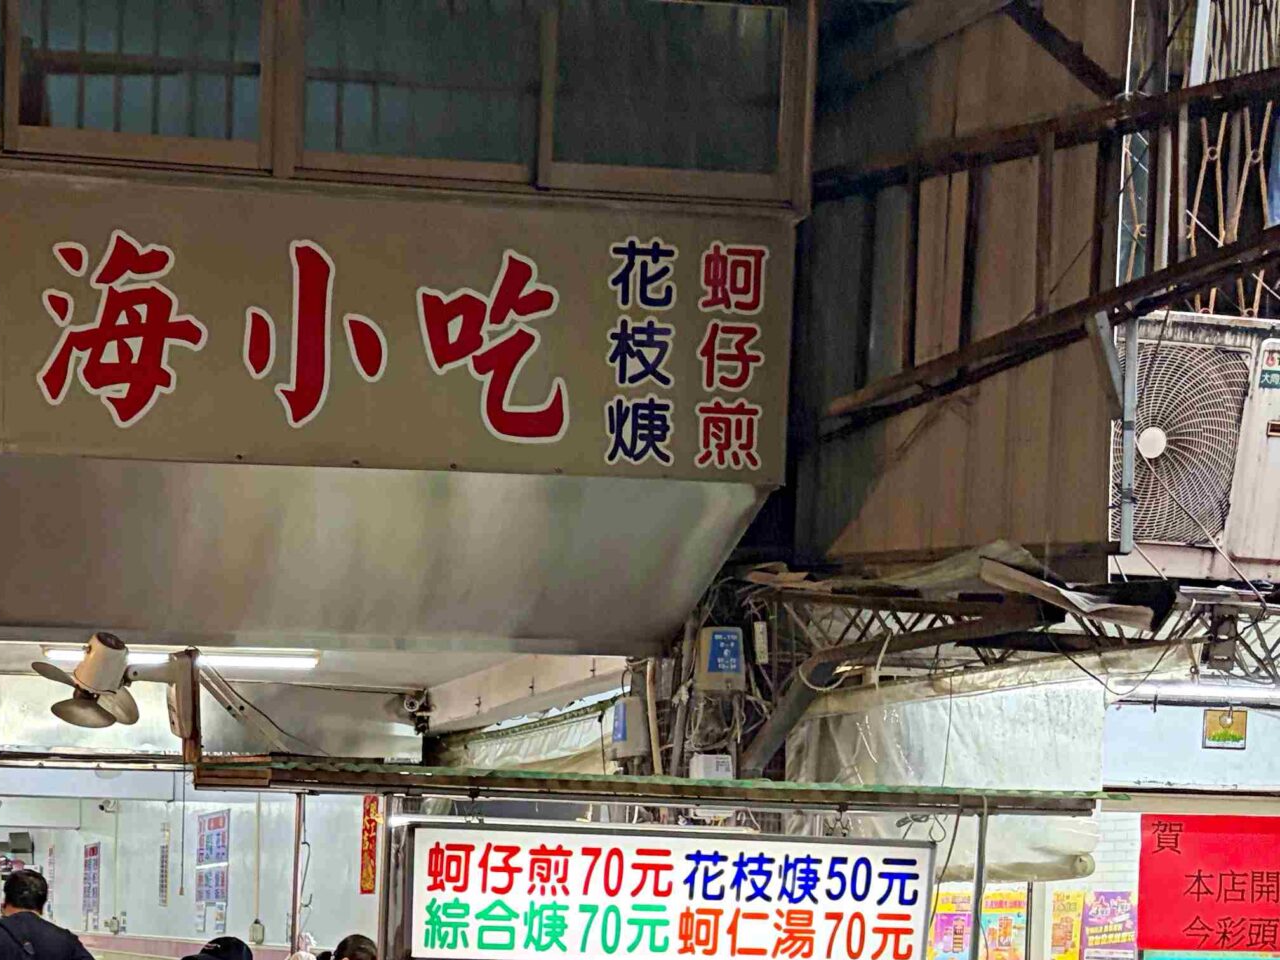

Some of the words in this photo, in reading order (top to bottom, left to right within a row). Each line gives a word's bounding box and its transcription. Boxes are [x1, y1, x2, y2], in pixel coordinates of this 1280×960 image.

[696, 242, 769, 468] 蚵仔煎
[1151, 820, 1183, 855] 賀
[426, 842, 674, 898] 蚵仔煎70元
[1183, 868, 1280, 904] 本店開
[677, 906, 914, 960] 蚵仁湯70元
[1182, 915, 1280, 950] 今彩頭
